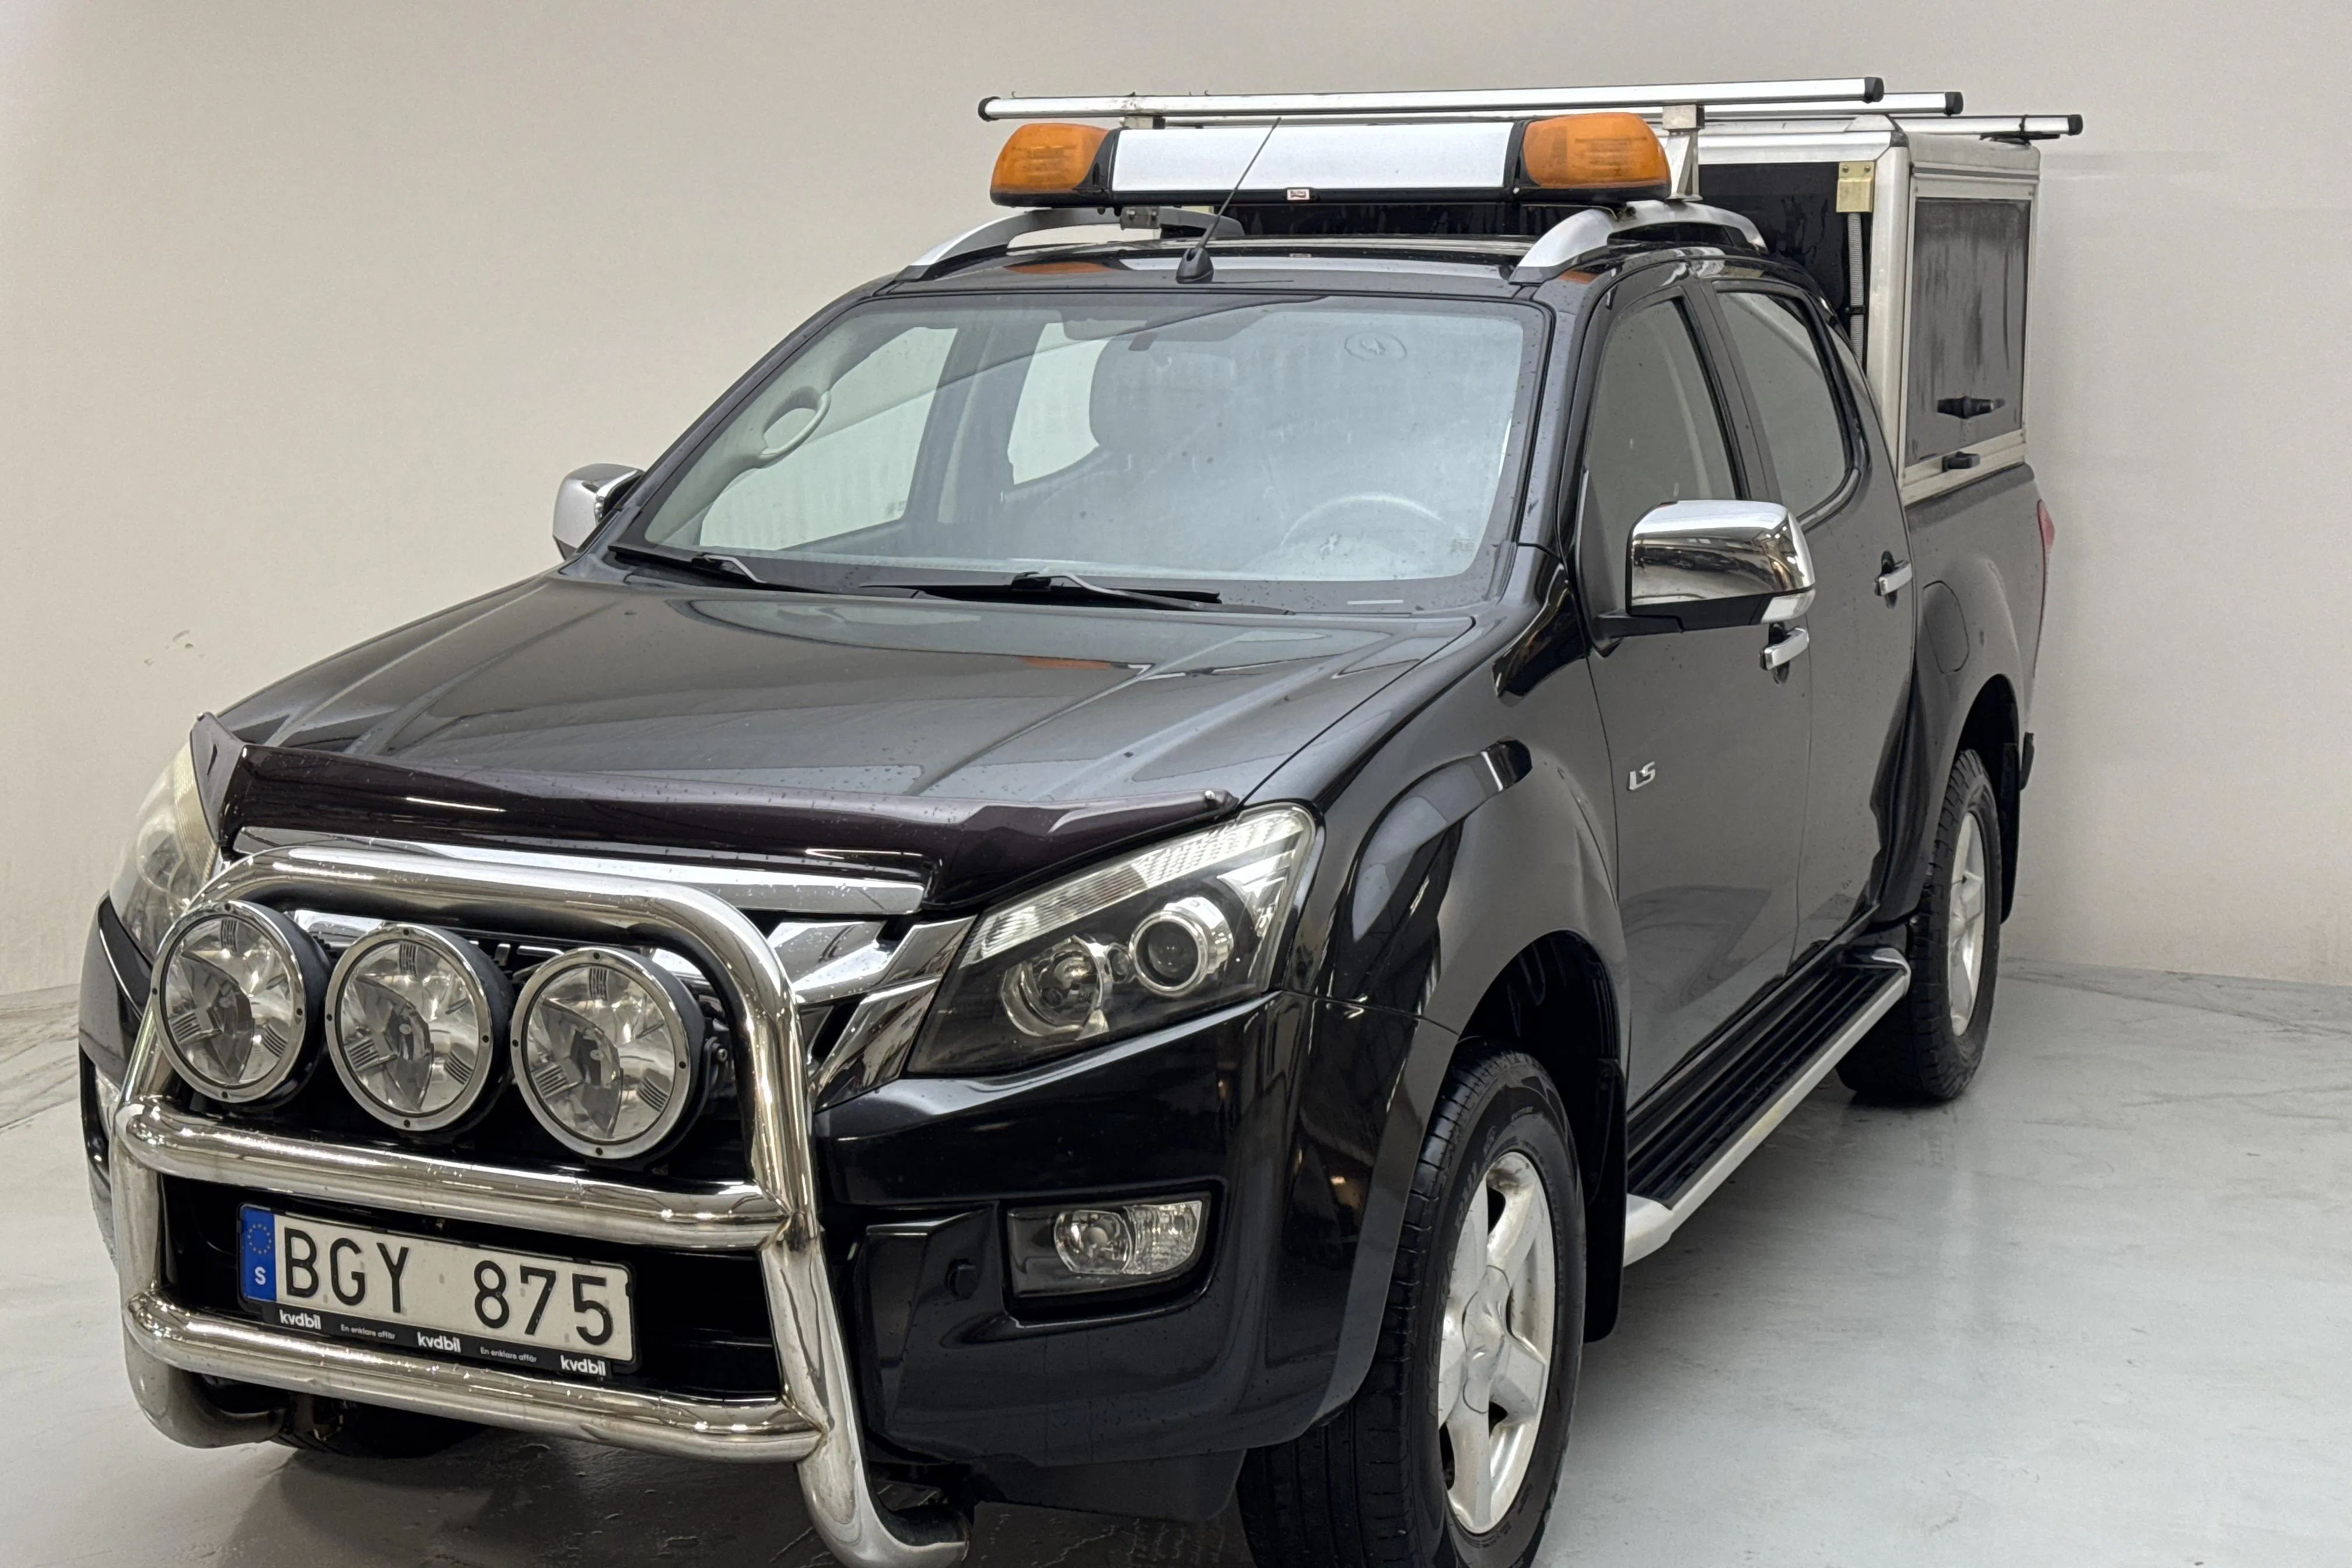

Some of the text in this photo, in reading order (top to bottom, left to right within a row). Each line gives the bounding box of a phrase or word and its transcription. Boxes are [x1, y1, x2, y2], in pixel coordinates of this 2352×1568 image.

[1629, 761, 1656, 790] LS
[254, 1266, 266, 1284] S
[284, 1227, 612, 1345] BGY 875
[279, 1309, 321, 1330] kvdbil
[340, 1323, 350, 1332] En
[351, 1326, 376, 1338] enklare
[417, 1331, 461, 1353] kvdbil
[480, 1346, 490, 1355] En
[491, 1349, 517, 1360] enklare
[560, 1354, 606, 1377] kvdbil
